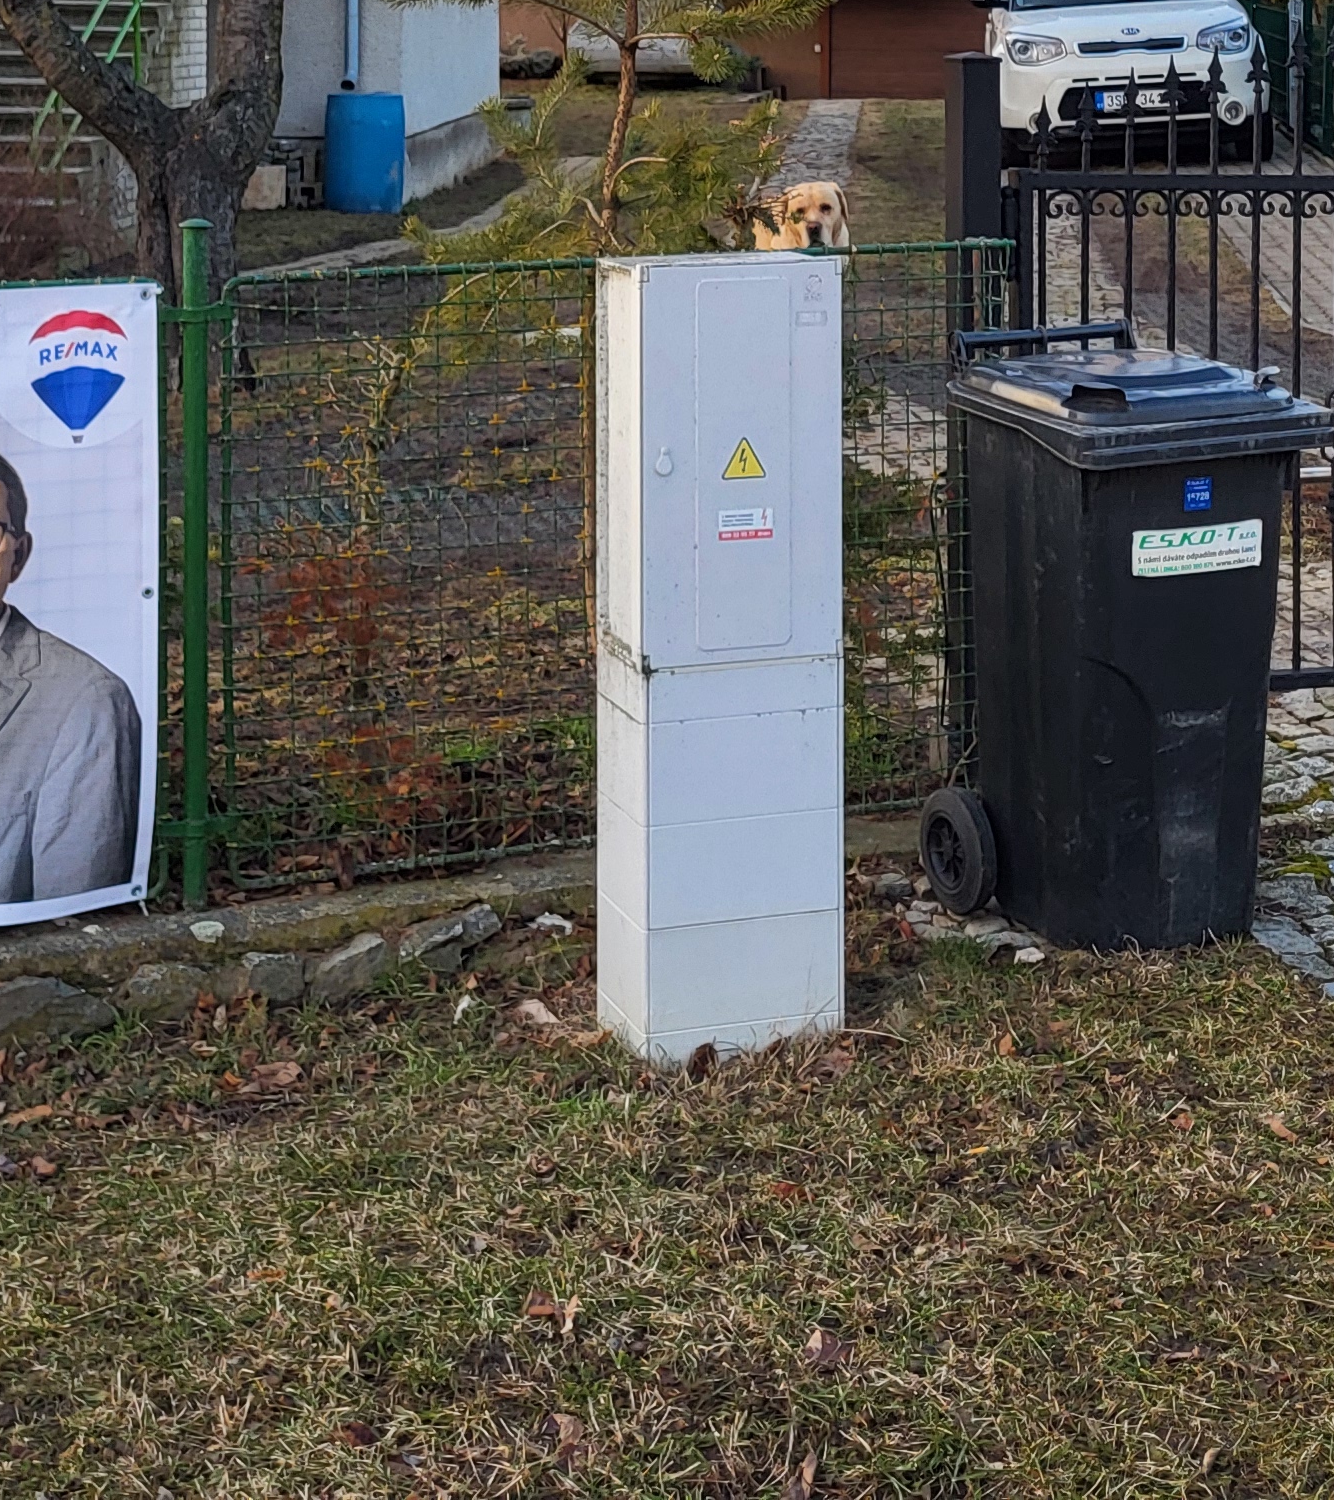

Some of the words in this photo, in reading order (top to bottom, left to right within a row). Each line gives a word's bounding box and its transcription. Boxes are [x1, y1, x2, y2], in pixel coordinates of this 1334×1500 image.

[39, 340, 118, 366] RE/MAX
[1139, 526, 1240, 549] ESKO-T
[1143, 555, 1161, 564] námi
[1163, 554, 1185, 563] dáváte
